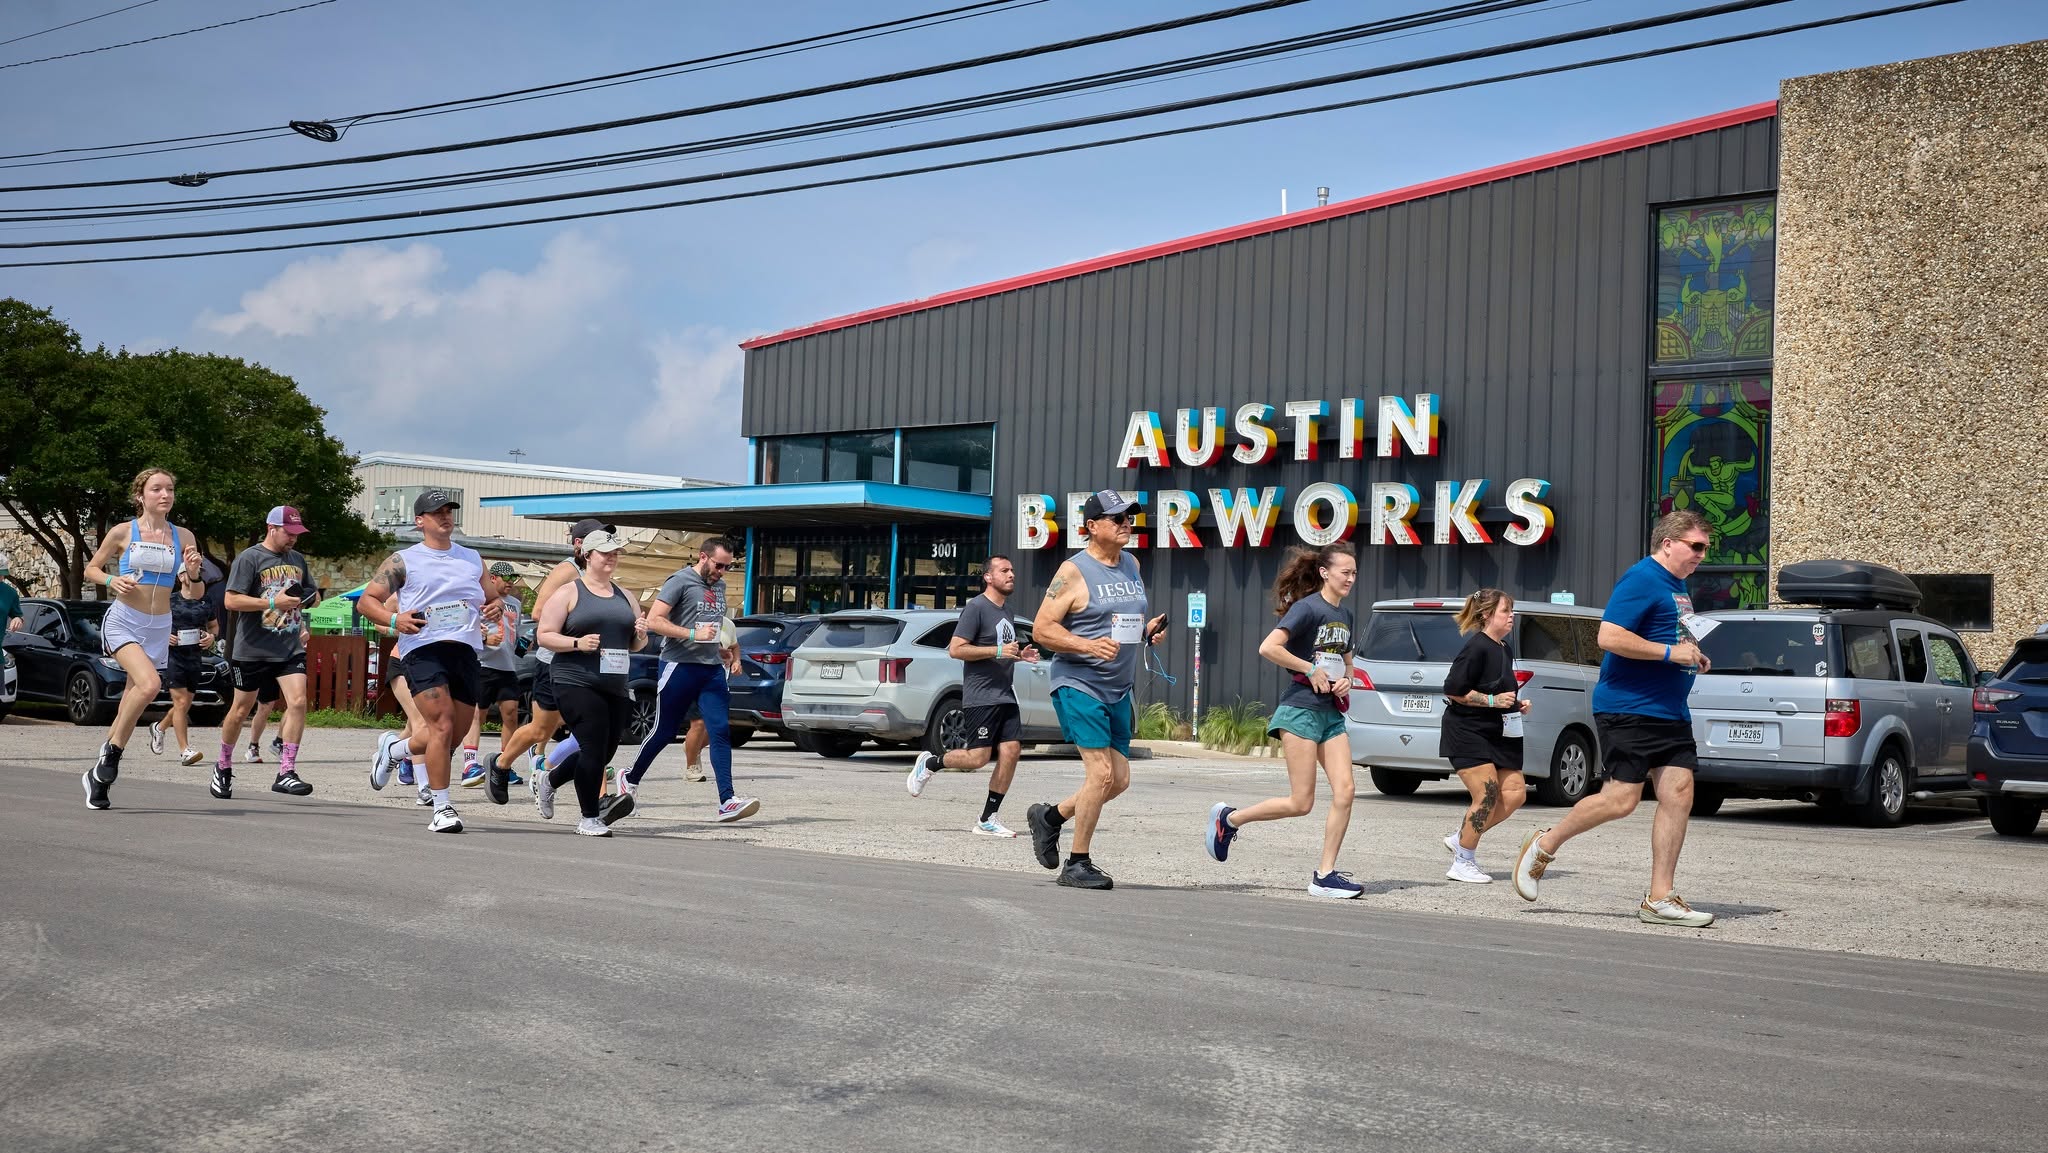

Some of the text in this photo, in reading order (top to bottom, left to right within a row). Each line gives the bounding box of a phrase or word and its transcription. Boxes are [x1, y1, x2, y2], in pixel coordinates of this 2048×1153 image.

[1116, 393, 1439, 468] AUSTIN
[931, 543, 957, 558] 3001
[1096, 580, 1144, 598] JESUS
[697, 602, 726, 611] BEARS
